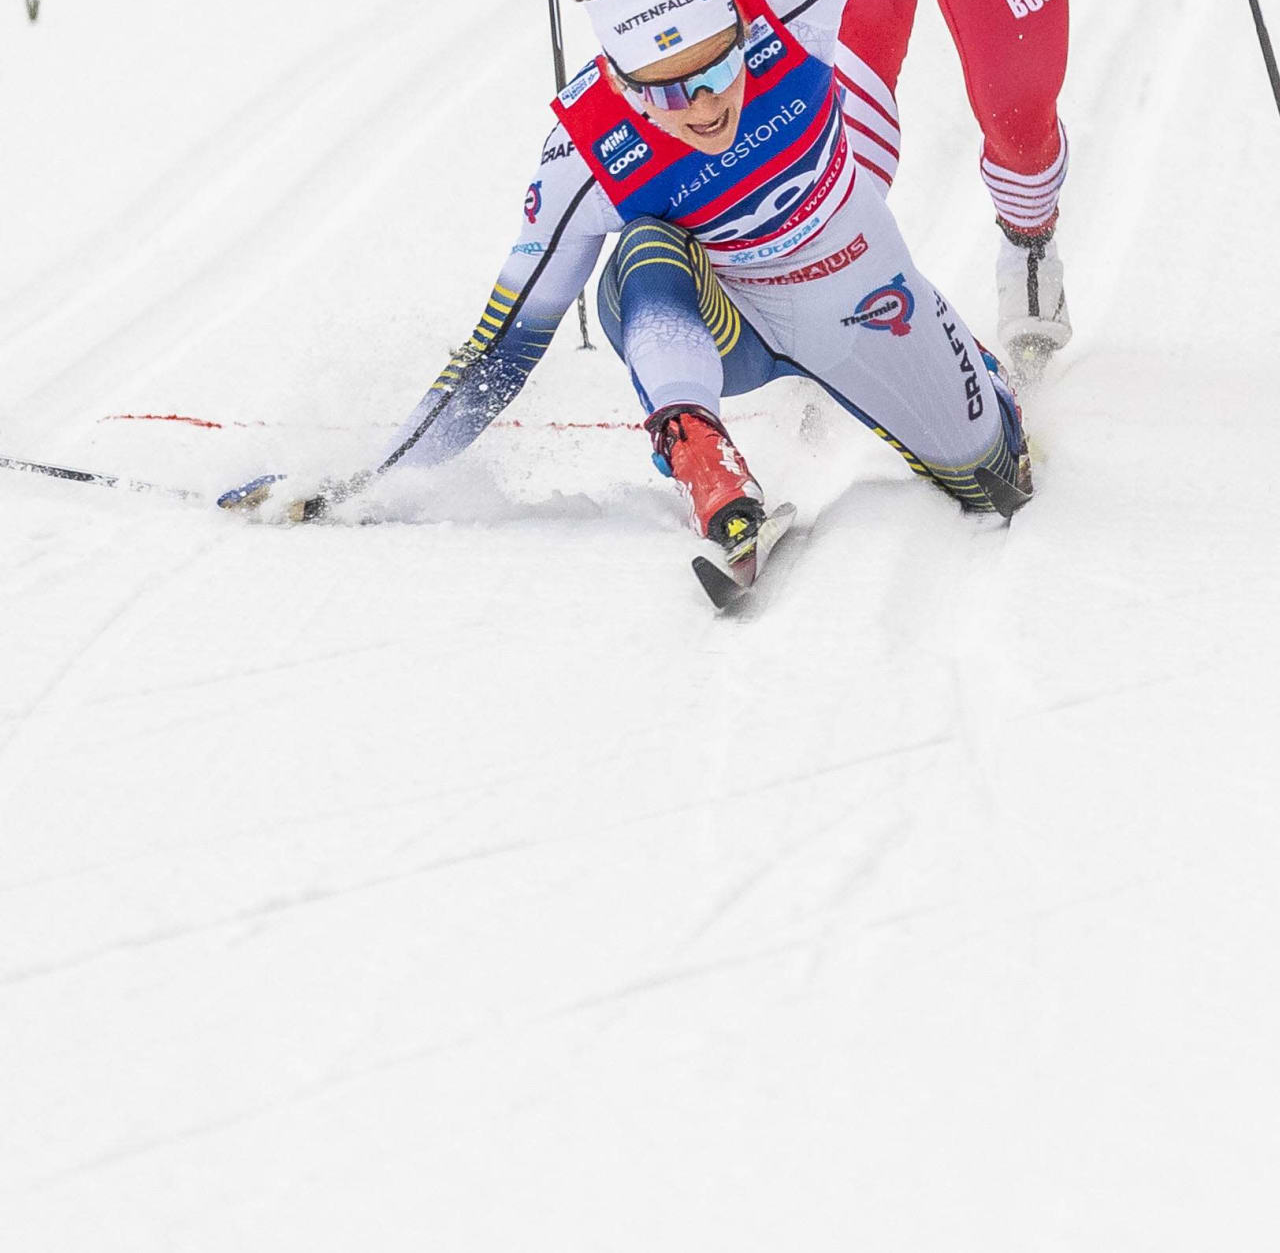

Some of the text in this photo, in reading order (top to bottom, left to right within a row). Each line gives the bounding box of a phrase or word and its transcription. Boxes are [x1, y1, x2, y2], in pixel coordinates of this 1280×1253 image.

[747, 40, 782, 69] coop
[541, 140, 576, 166] CRAF
[609, 142, 648, 176] coop
[670, 161, 722, 208] visit
[720, 96, 808, 170] estonia
[840, 299, 900, 328] Thermia
[943, 322, 984, 421] CRAFT
